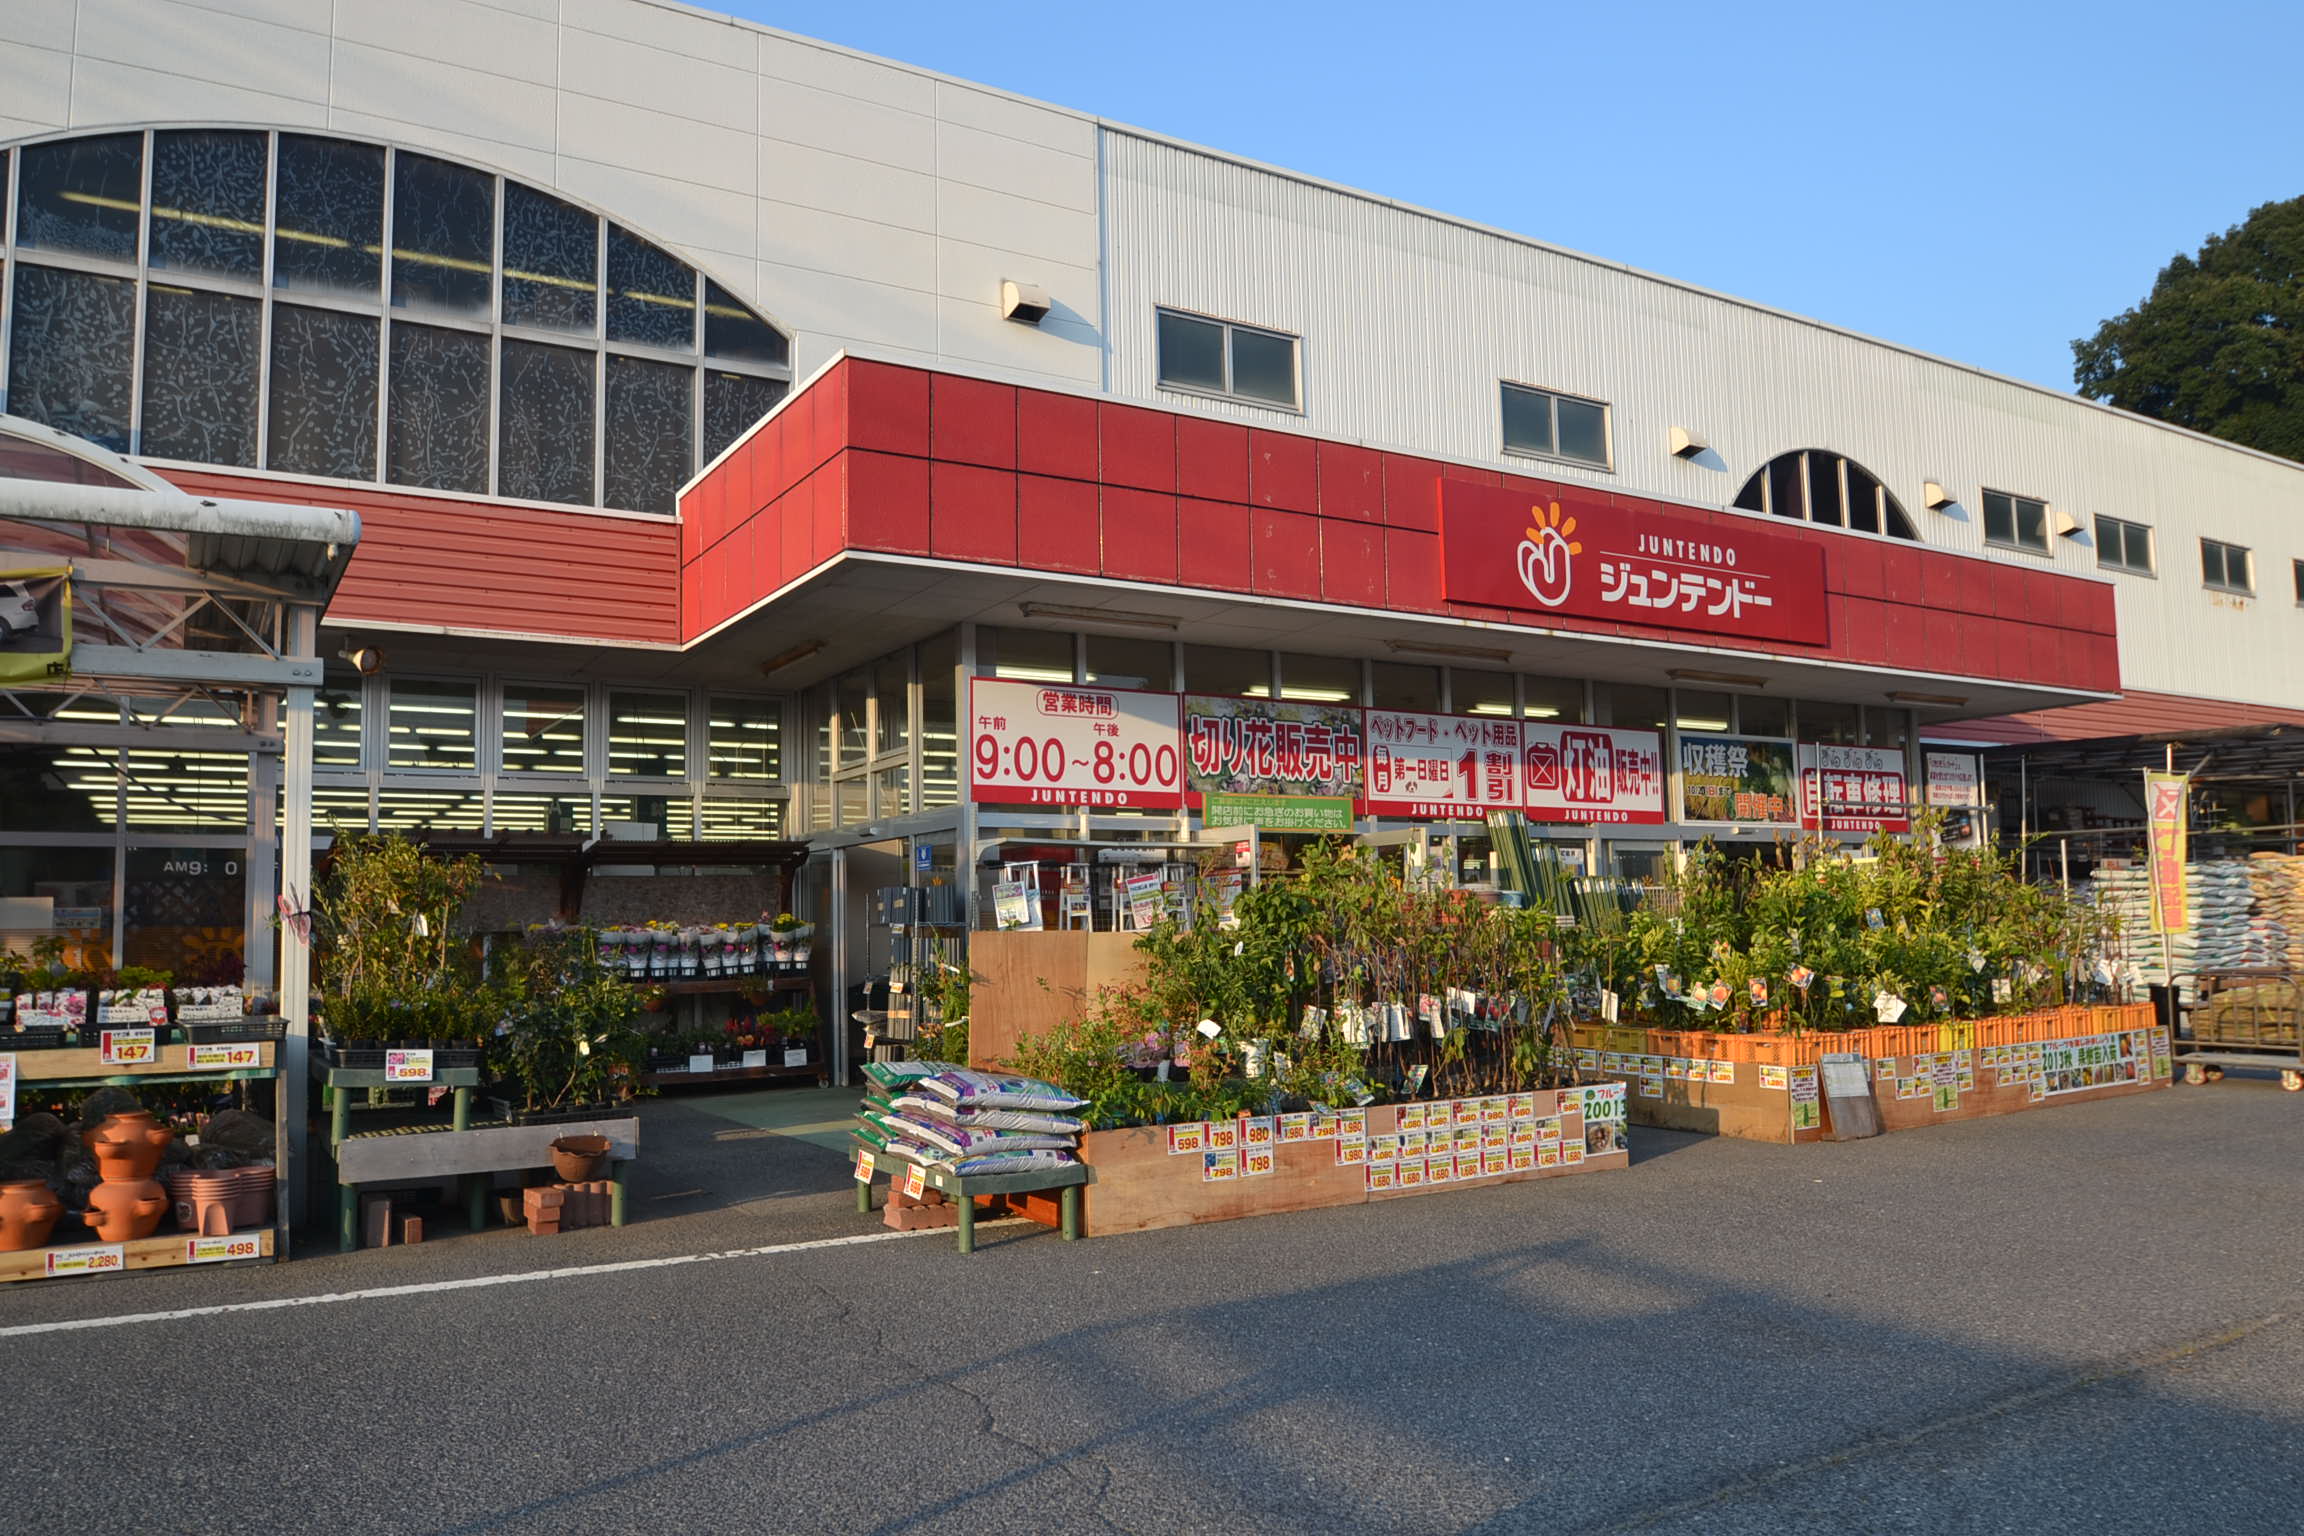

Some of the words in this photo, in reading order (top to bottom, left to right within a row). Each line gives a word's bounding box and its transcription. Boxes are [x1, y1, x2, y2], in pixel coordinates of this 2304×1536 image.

[1638, 533, 1737, 567] JUNTENDO
[1599, 563, 1773, 618] ジュンテンドー
[1041, 691, 1113, 716] 営業時間
[978, 715, 1007, 731] 午前
[1093, 722, 1119, 738] 午後
[1188, 712, 1361, 784] 切り花販売中
[1563, 735, 1612, 800] 灯油
[1683, 742, 1748, 778] 収穫祭
[1376, 746, 1388, 790] 毎月
[1394, 757, 1449, 782] 第一日曜日
[1030, 789, 1128, 806] JUNTENDO
[1805, 771, 1903, 815] 自転車修理
[1411, 803, 1484, 817] JUNTENDO
[1564, 809, 1628, 822] JUNTENDO
[1831, 819, 1881, 830] JUNTENDO
[117, 1046, 149, 1060] 147
[226, 1050, 255, 1064] 147
[400, 1068, 427, 1077] 598
[1213, 1131, 1233, 1146] 798
[1249, 1127, 1269, 1142] 980
[1316, 1126, 1335, 1136] 798
[1178, 1137, 1199, 1150] 598
[1250, 1155, 1270, 1171] 798
[1212, 1167, 1233, 1177] 798
[227, 1242, 254, 1255] 498
[88, 1255, 118, 1269] 2,280
